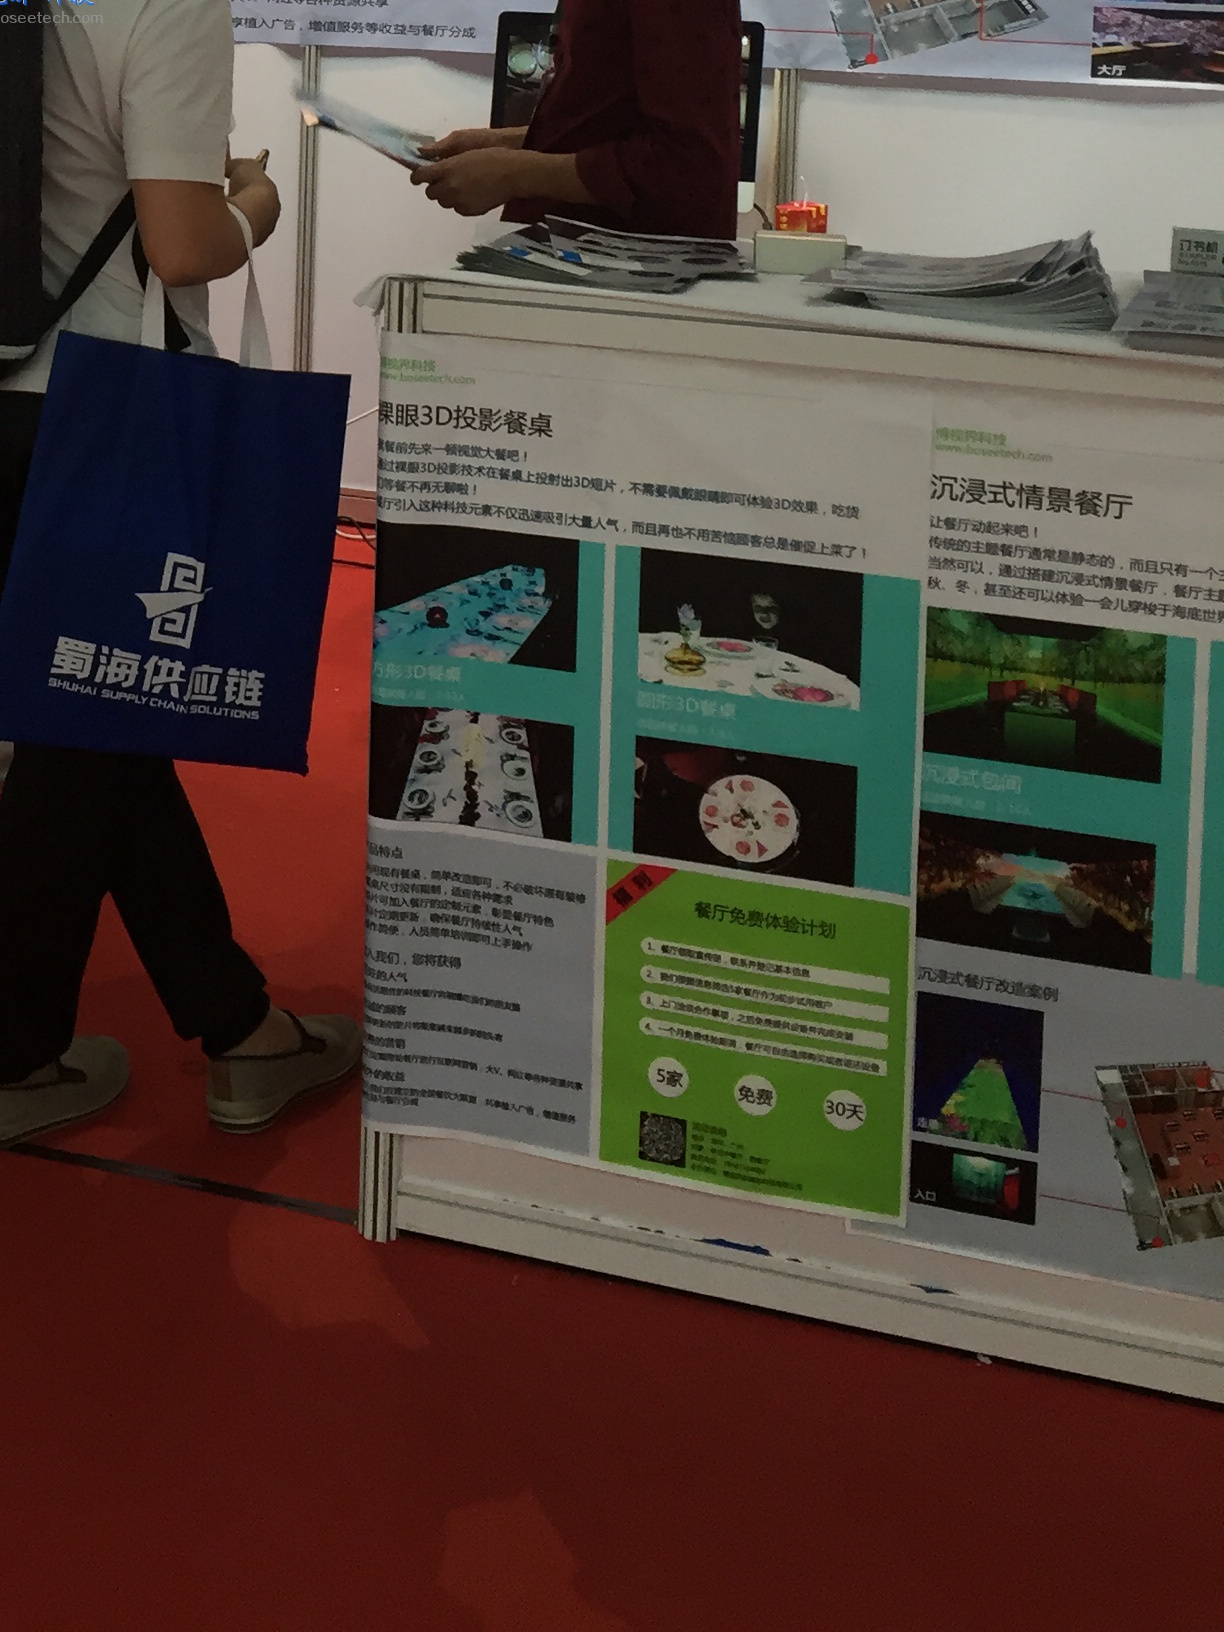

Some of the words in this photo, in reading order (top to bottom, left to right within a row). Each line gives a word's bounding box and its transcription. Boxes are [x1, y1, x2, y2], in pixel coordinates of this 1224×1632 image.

[1097, 63, 1127, 76] 大厅
[930, 473, 1133, 520] 沉浸式情景餐厅
[49, 635, 266, 708] 蜀海供应链
[47, 677, 97, 697] SHUHAI
[100, 688, 150, 706] SUPPLY
[148, 697, 189, 715] CHAIN
[189, 704, 261, 721] SOLUTIONS
[694, 899, 836, 940] 餐厅免费体验计划
[656, 1068, 684, 1089] 5家
[737, 1084, 774, 1108] 免费
[825, 1099, 864, 1123] 30天
[913, 1188, 937, 1203] 入口
